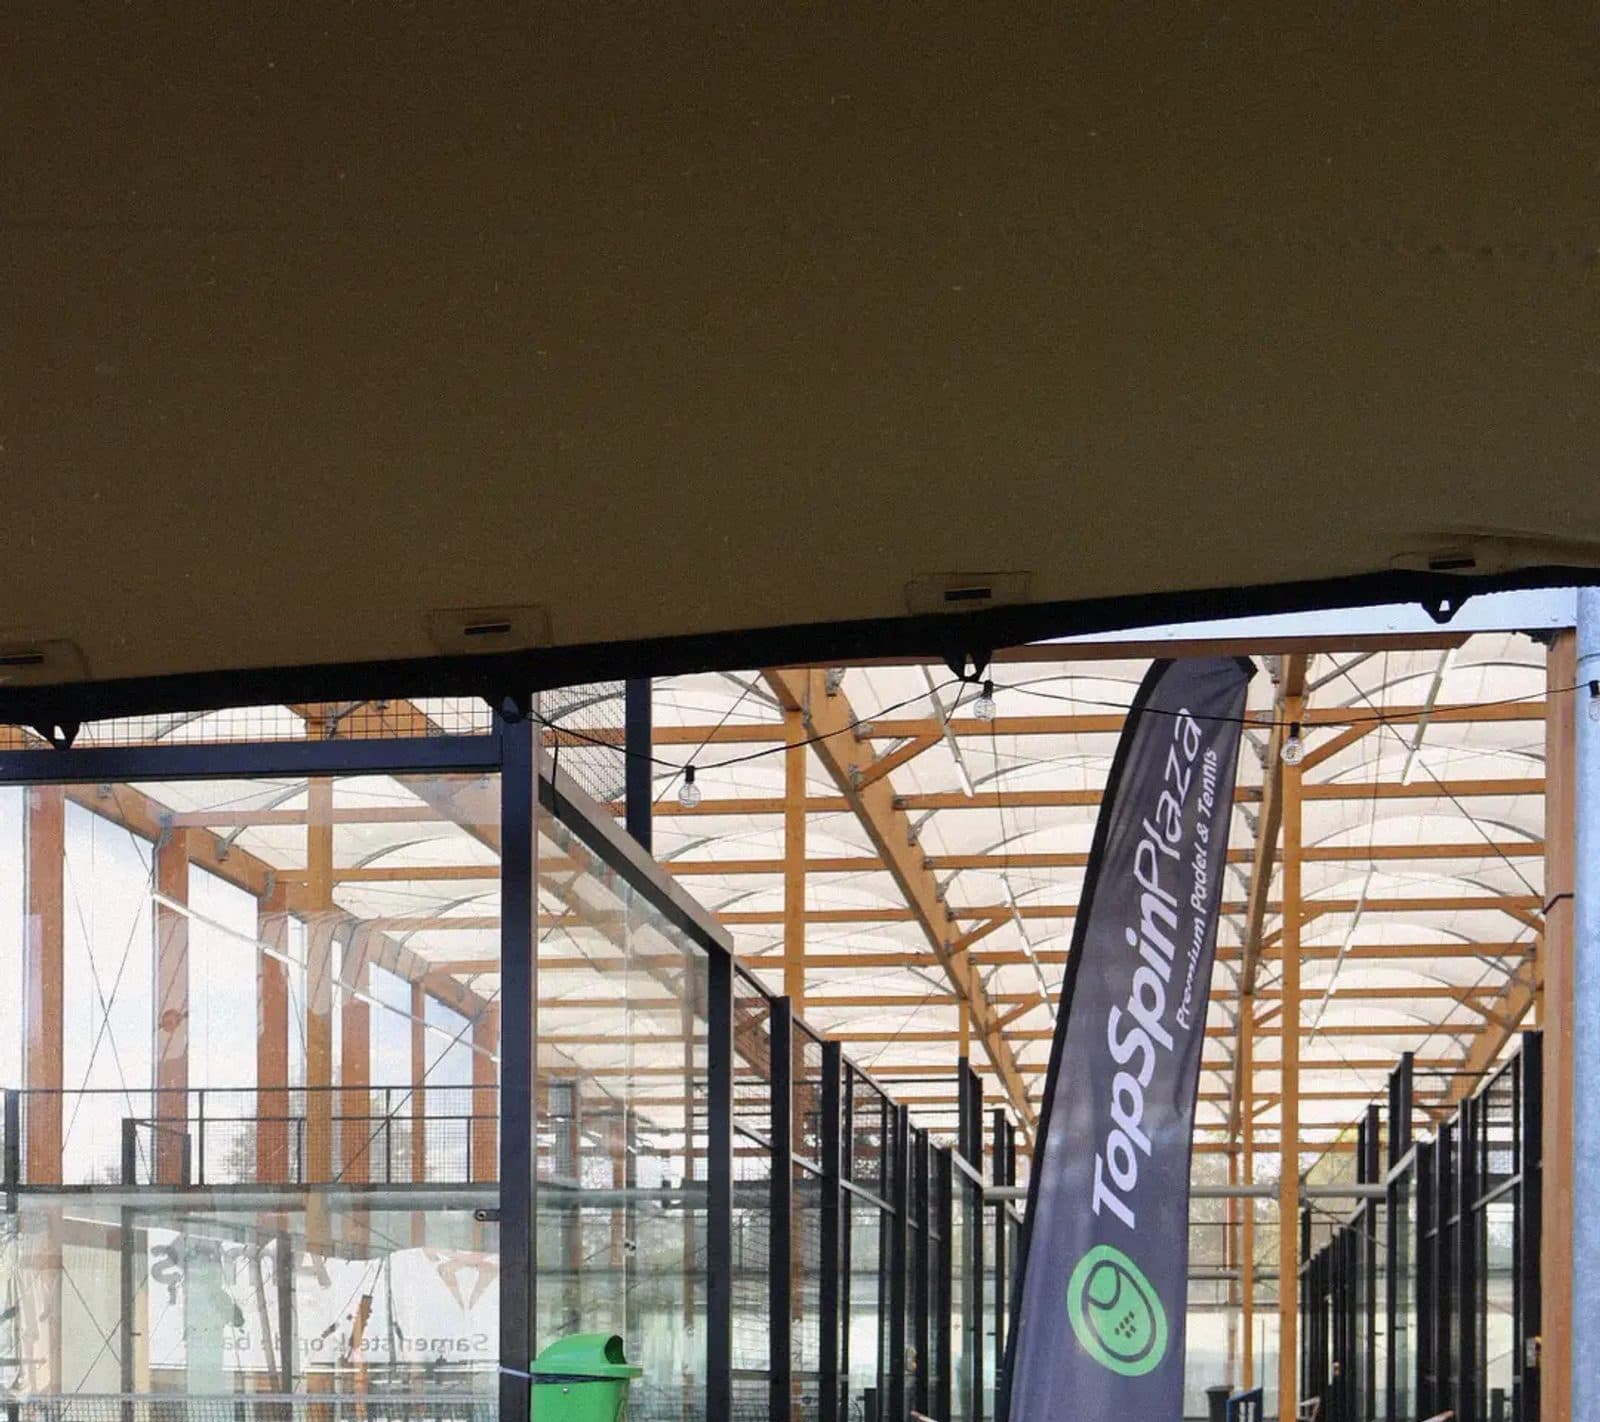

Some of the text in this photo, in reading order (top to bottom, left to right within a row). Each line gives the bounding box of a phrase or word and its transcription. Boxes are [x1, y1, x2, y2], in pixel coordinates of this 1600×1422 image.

[1092, 708, 1202, 1229] TopSpinPlaza
[1176, 747, 1217, 1030] Premium Padel & Tennis
